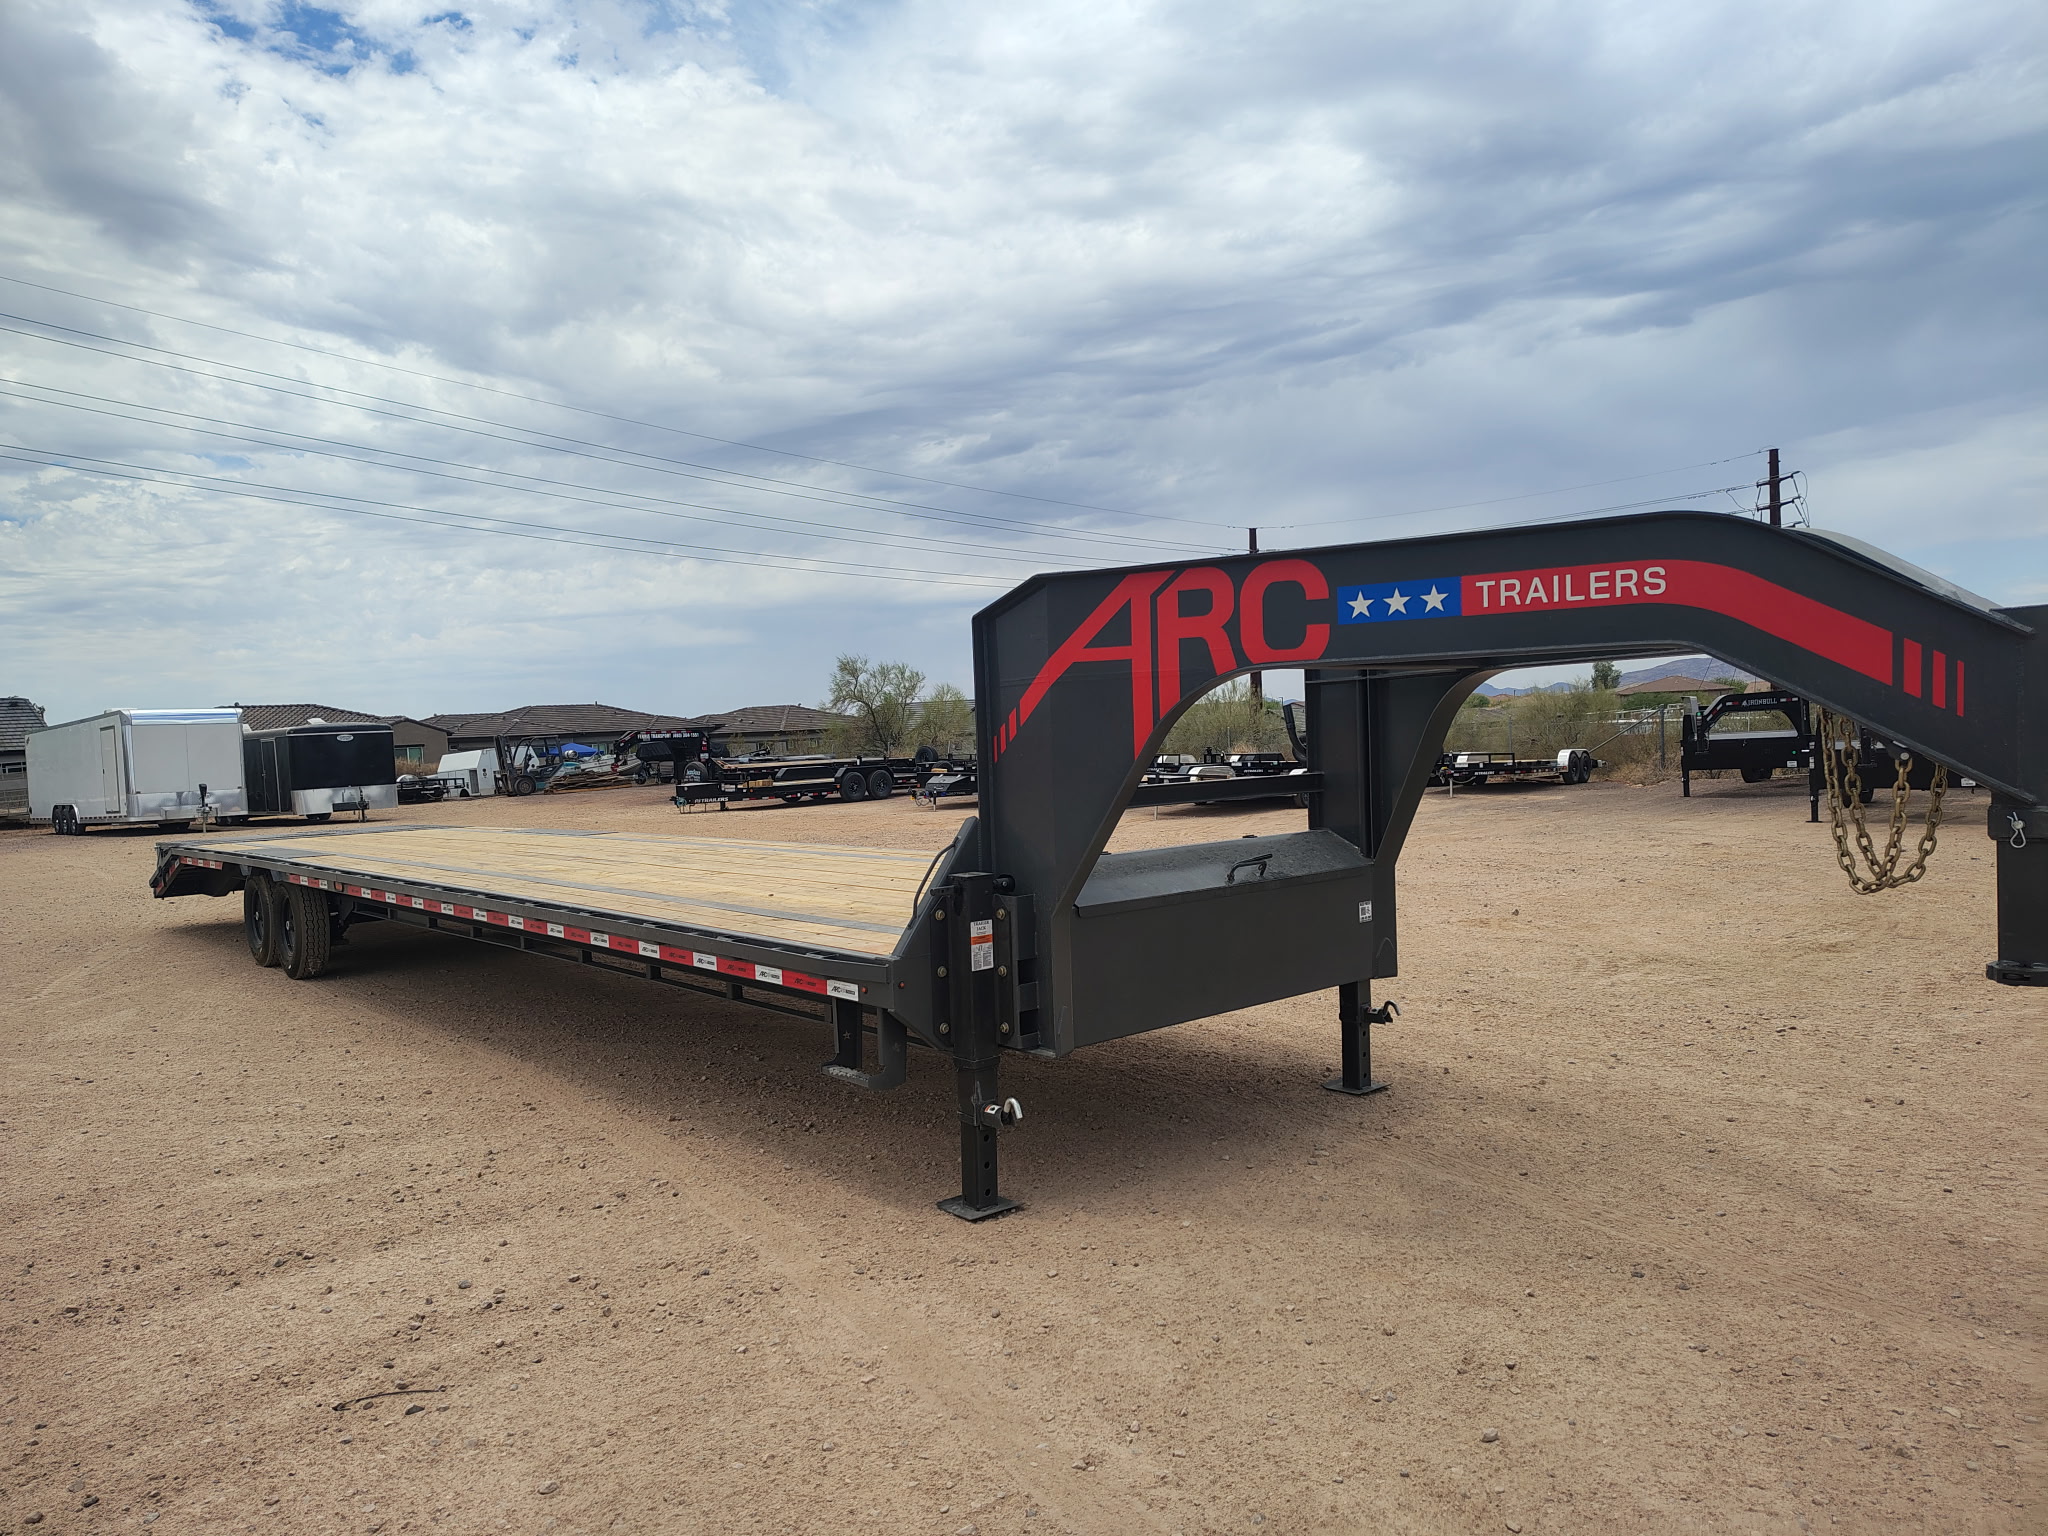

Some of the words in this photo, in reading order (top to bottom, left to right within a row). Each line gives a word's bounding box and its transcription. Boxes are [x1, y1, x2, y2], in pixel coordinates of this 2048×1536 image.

[1475, 566, 1667, 608] TRAILERS
[1019, 558, 1331, 762] ARC
[1748, 697, 1778, 706] IRONBULL
